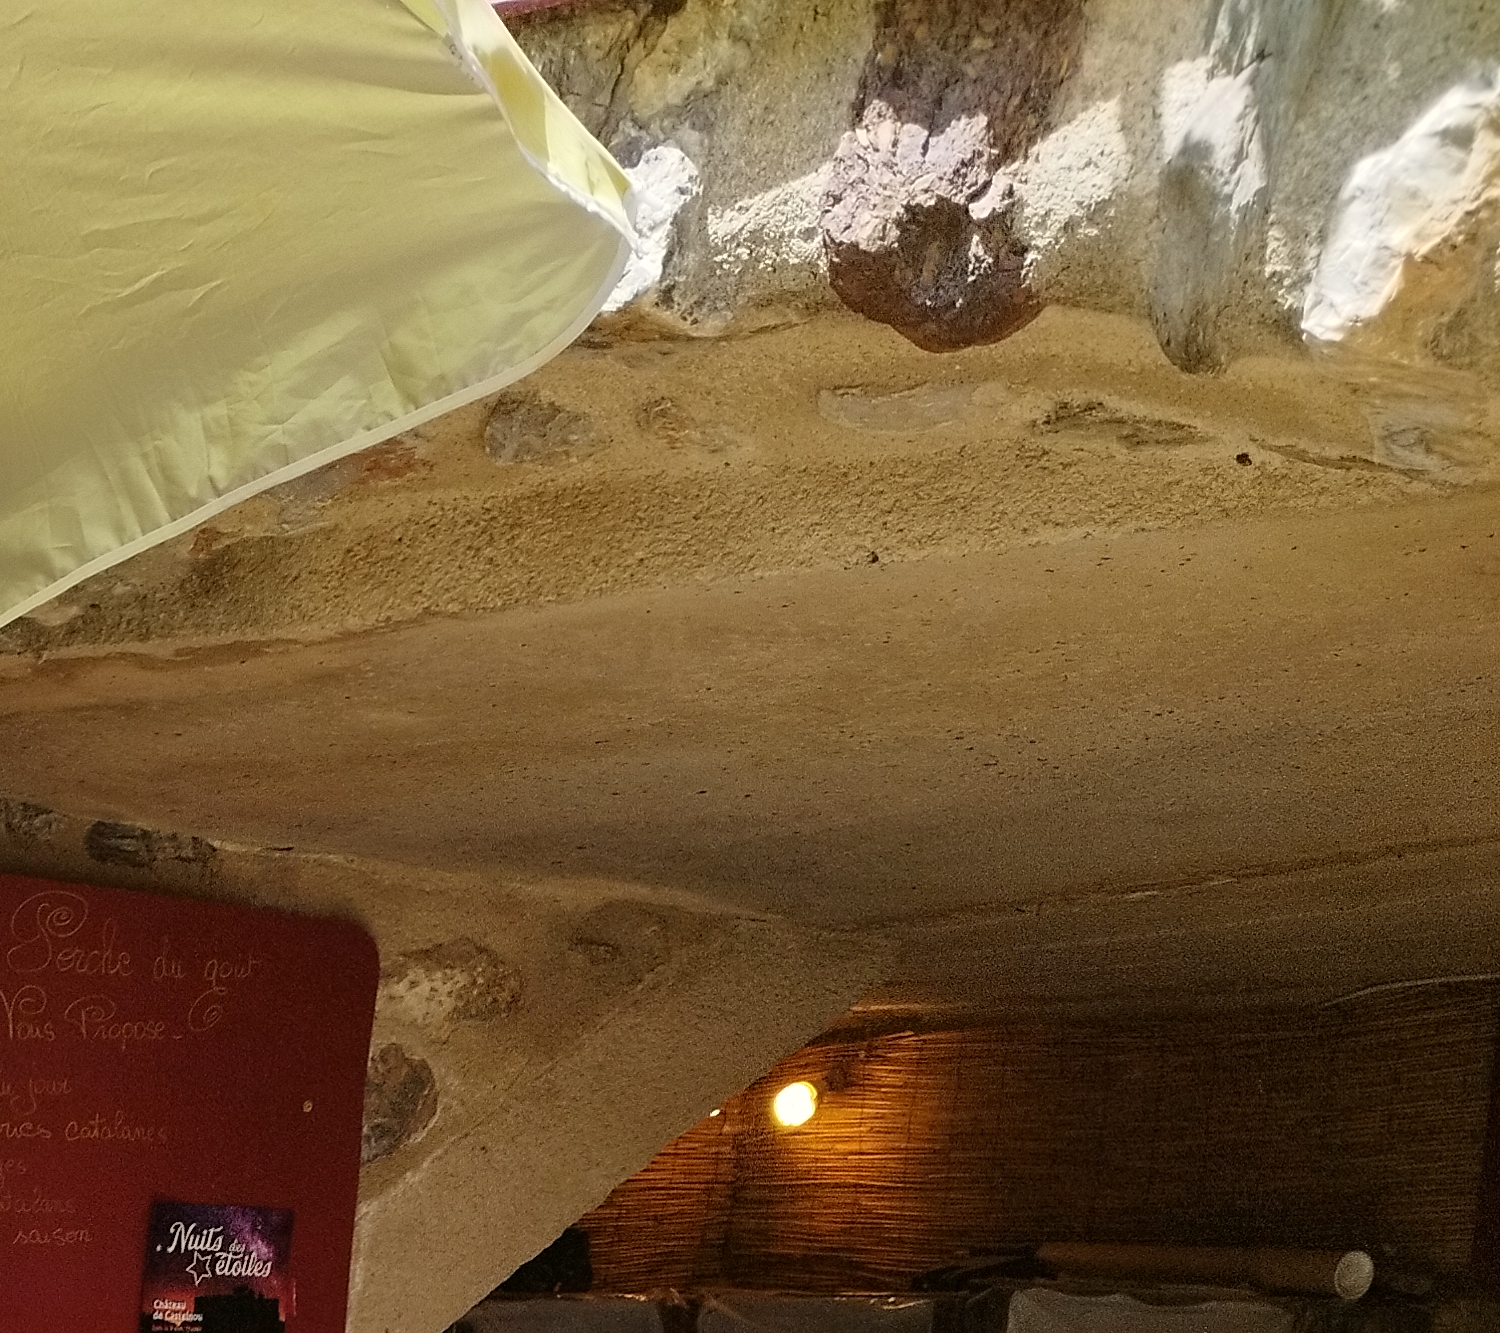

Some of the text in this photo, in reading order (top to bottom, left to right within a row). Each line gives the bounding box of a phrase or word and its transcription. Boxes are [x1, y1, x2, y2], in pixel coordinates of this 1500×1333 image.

[152, 940, 186, 980] du
[0, 985, 169, 1050] Vous Propose
[167, 1221, 225, 1254] Nuits
[215, 1252, 273, 1278] étoiles
